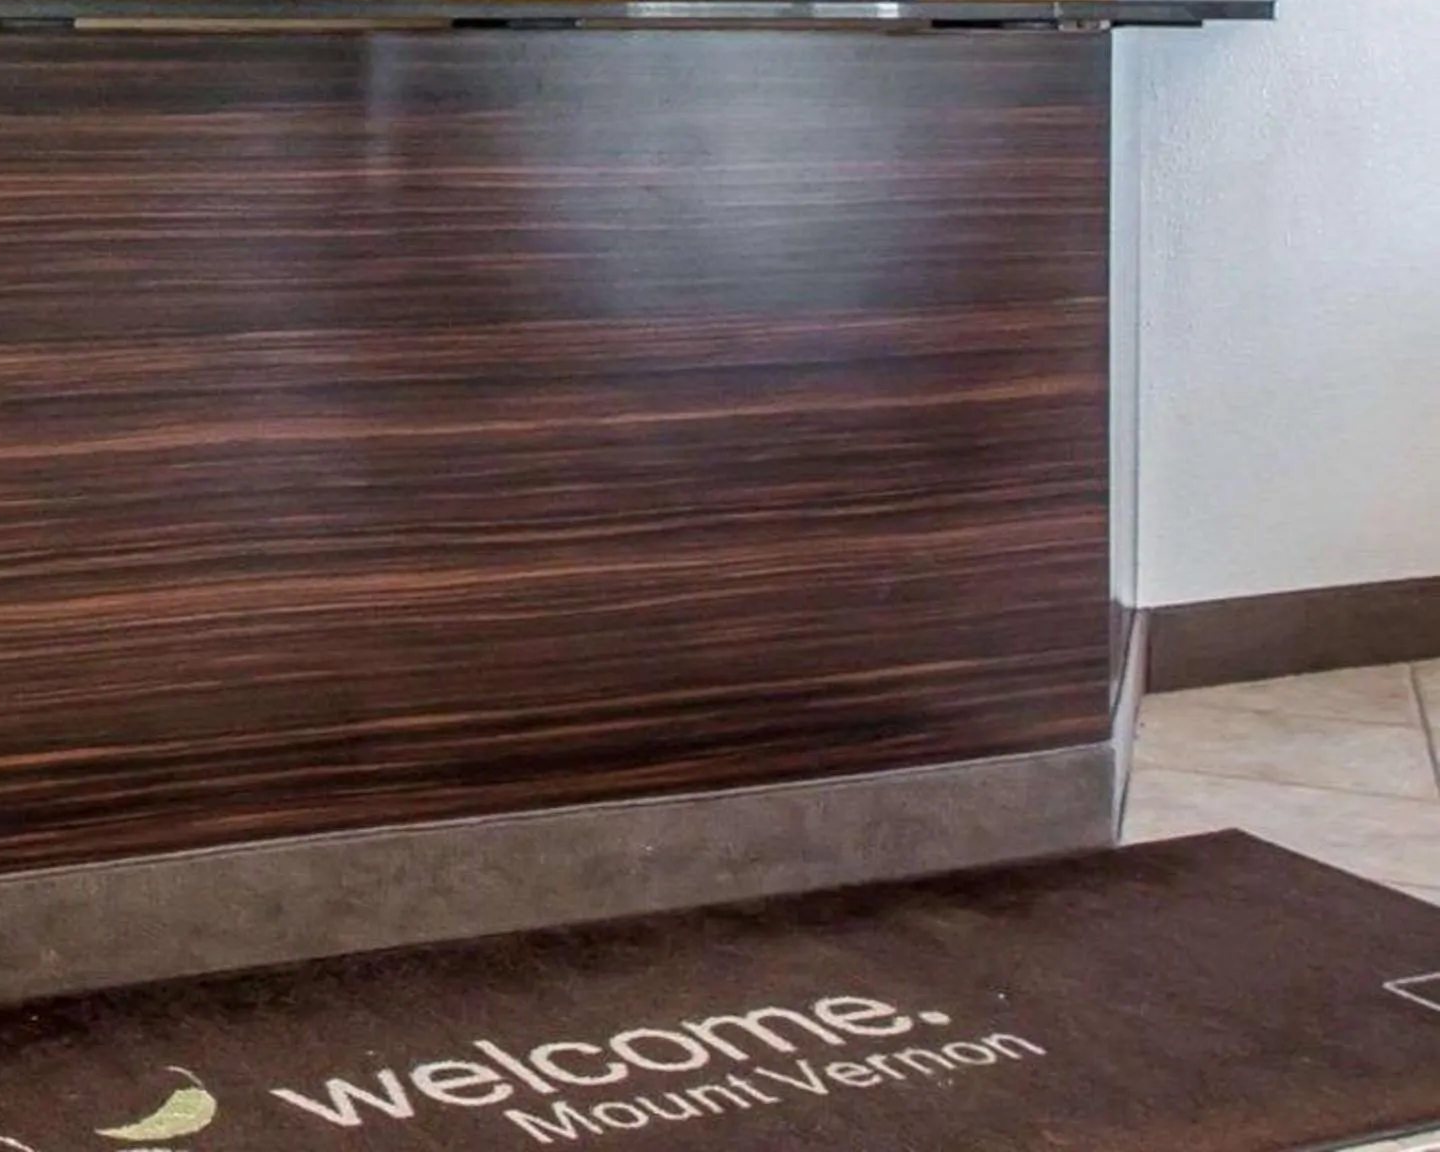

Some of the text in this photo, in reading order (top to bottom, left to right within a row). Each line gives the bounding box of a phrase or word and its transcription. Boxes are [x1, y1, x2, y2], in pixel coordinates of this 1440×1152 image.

[269, 996, 951, 1127] welcome.
[504, 1032, 1047, 1144] Mount Vernon
